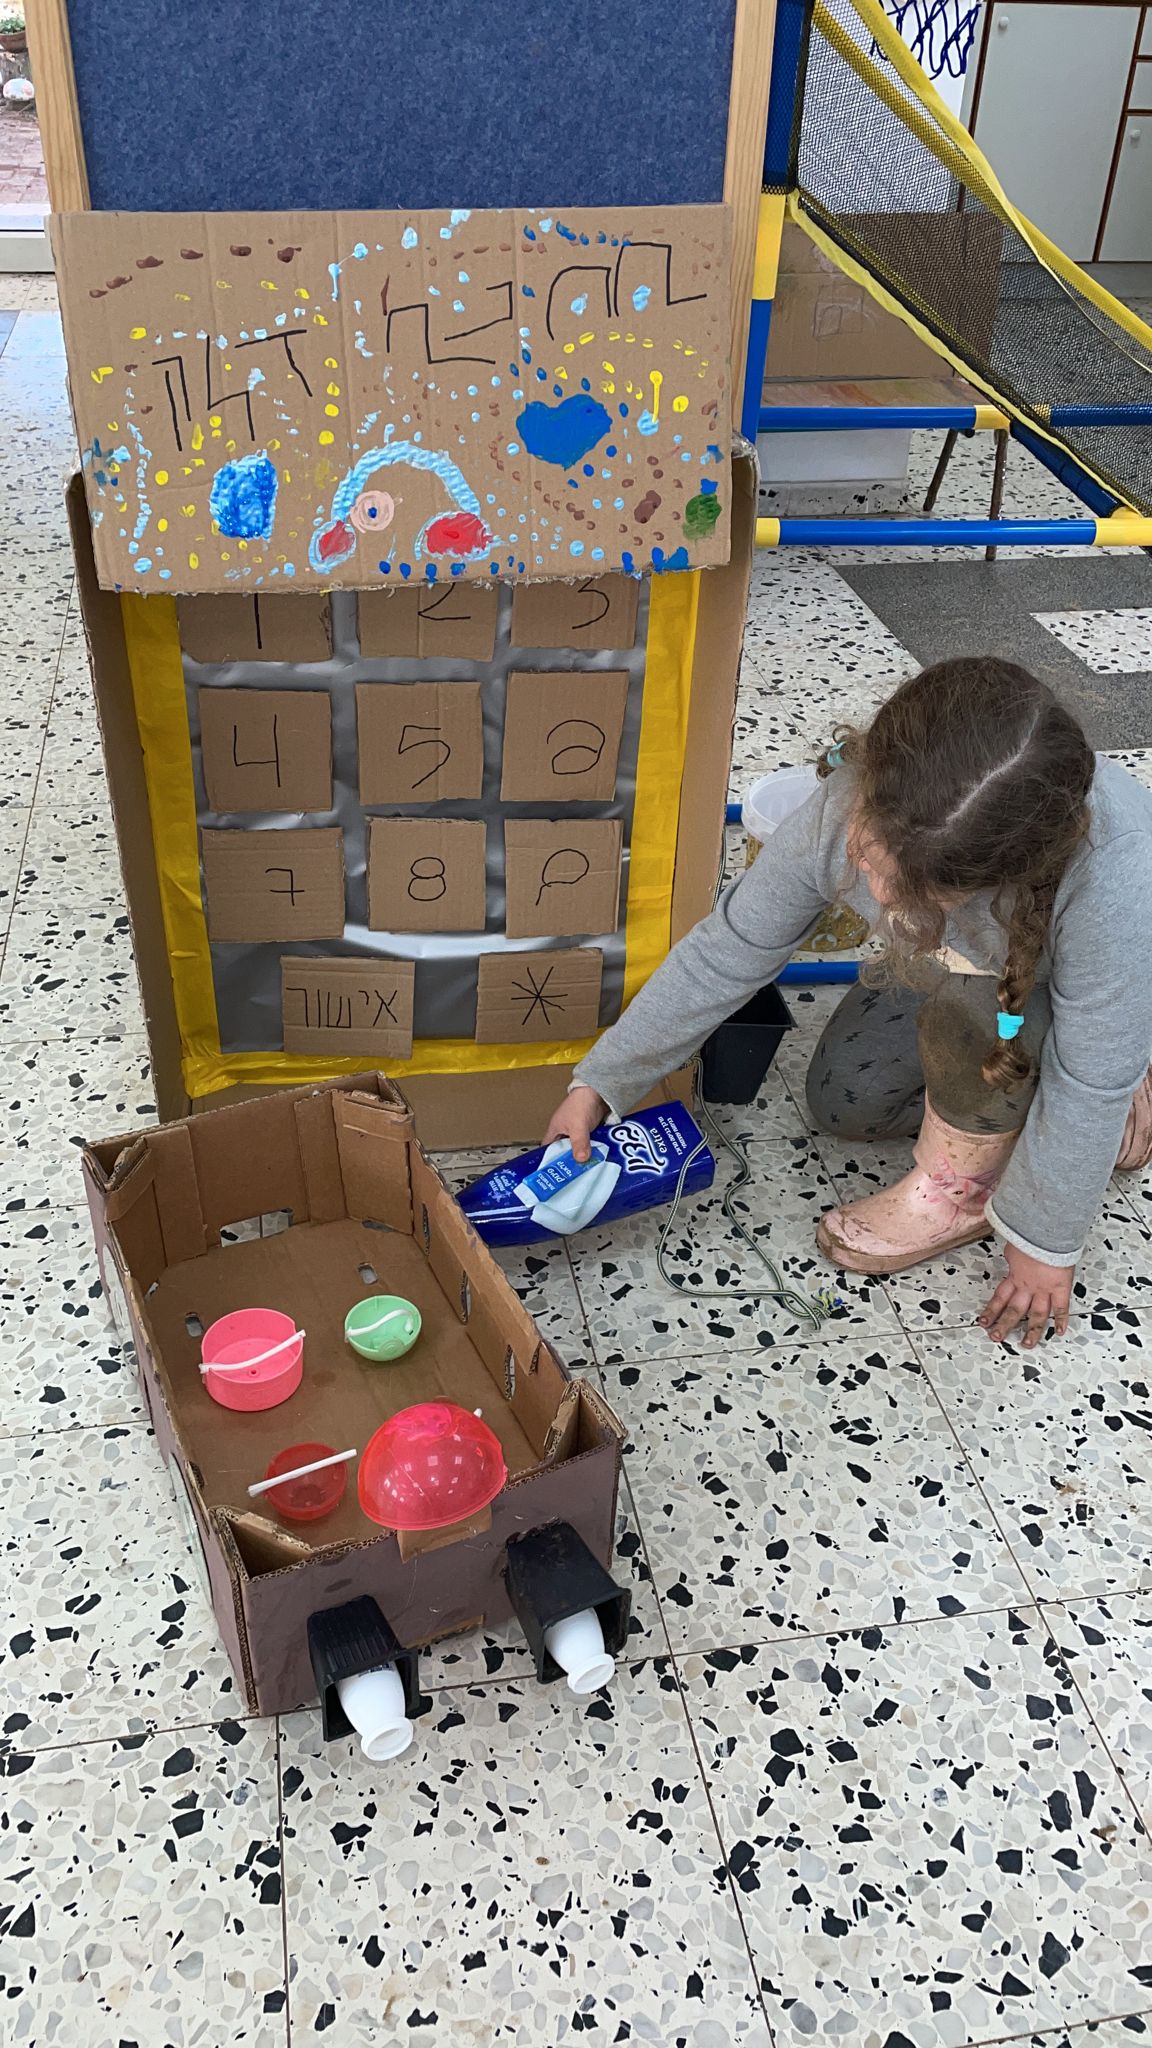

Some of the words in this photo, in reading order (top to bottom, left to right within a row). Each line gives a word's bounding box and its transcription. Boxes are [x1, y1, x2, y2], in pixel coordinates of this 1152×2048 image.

[384, 242, 707, 364] תחנת
[151, 329, 313, 452] דלק
[233, 713, 281, 788] 4
[398, 724, 451, 790] 5
[265, 867, 305, 907] 7
[407, 856, 447, 901] 8
[286, 986, 398, 1029] אישור
[649, 1127, 667, 1153] extra
[547, 1168, 565, 1182] פינוק
